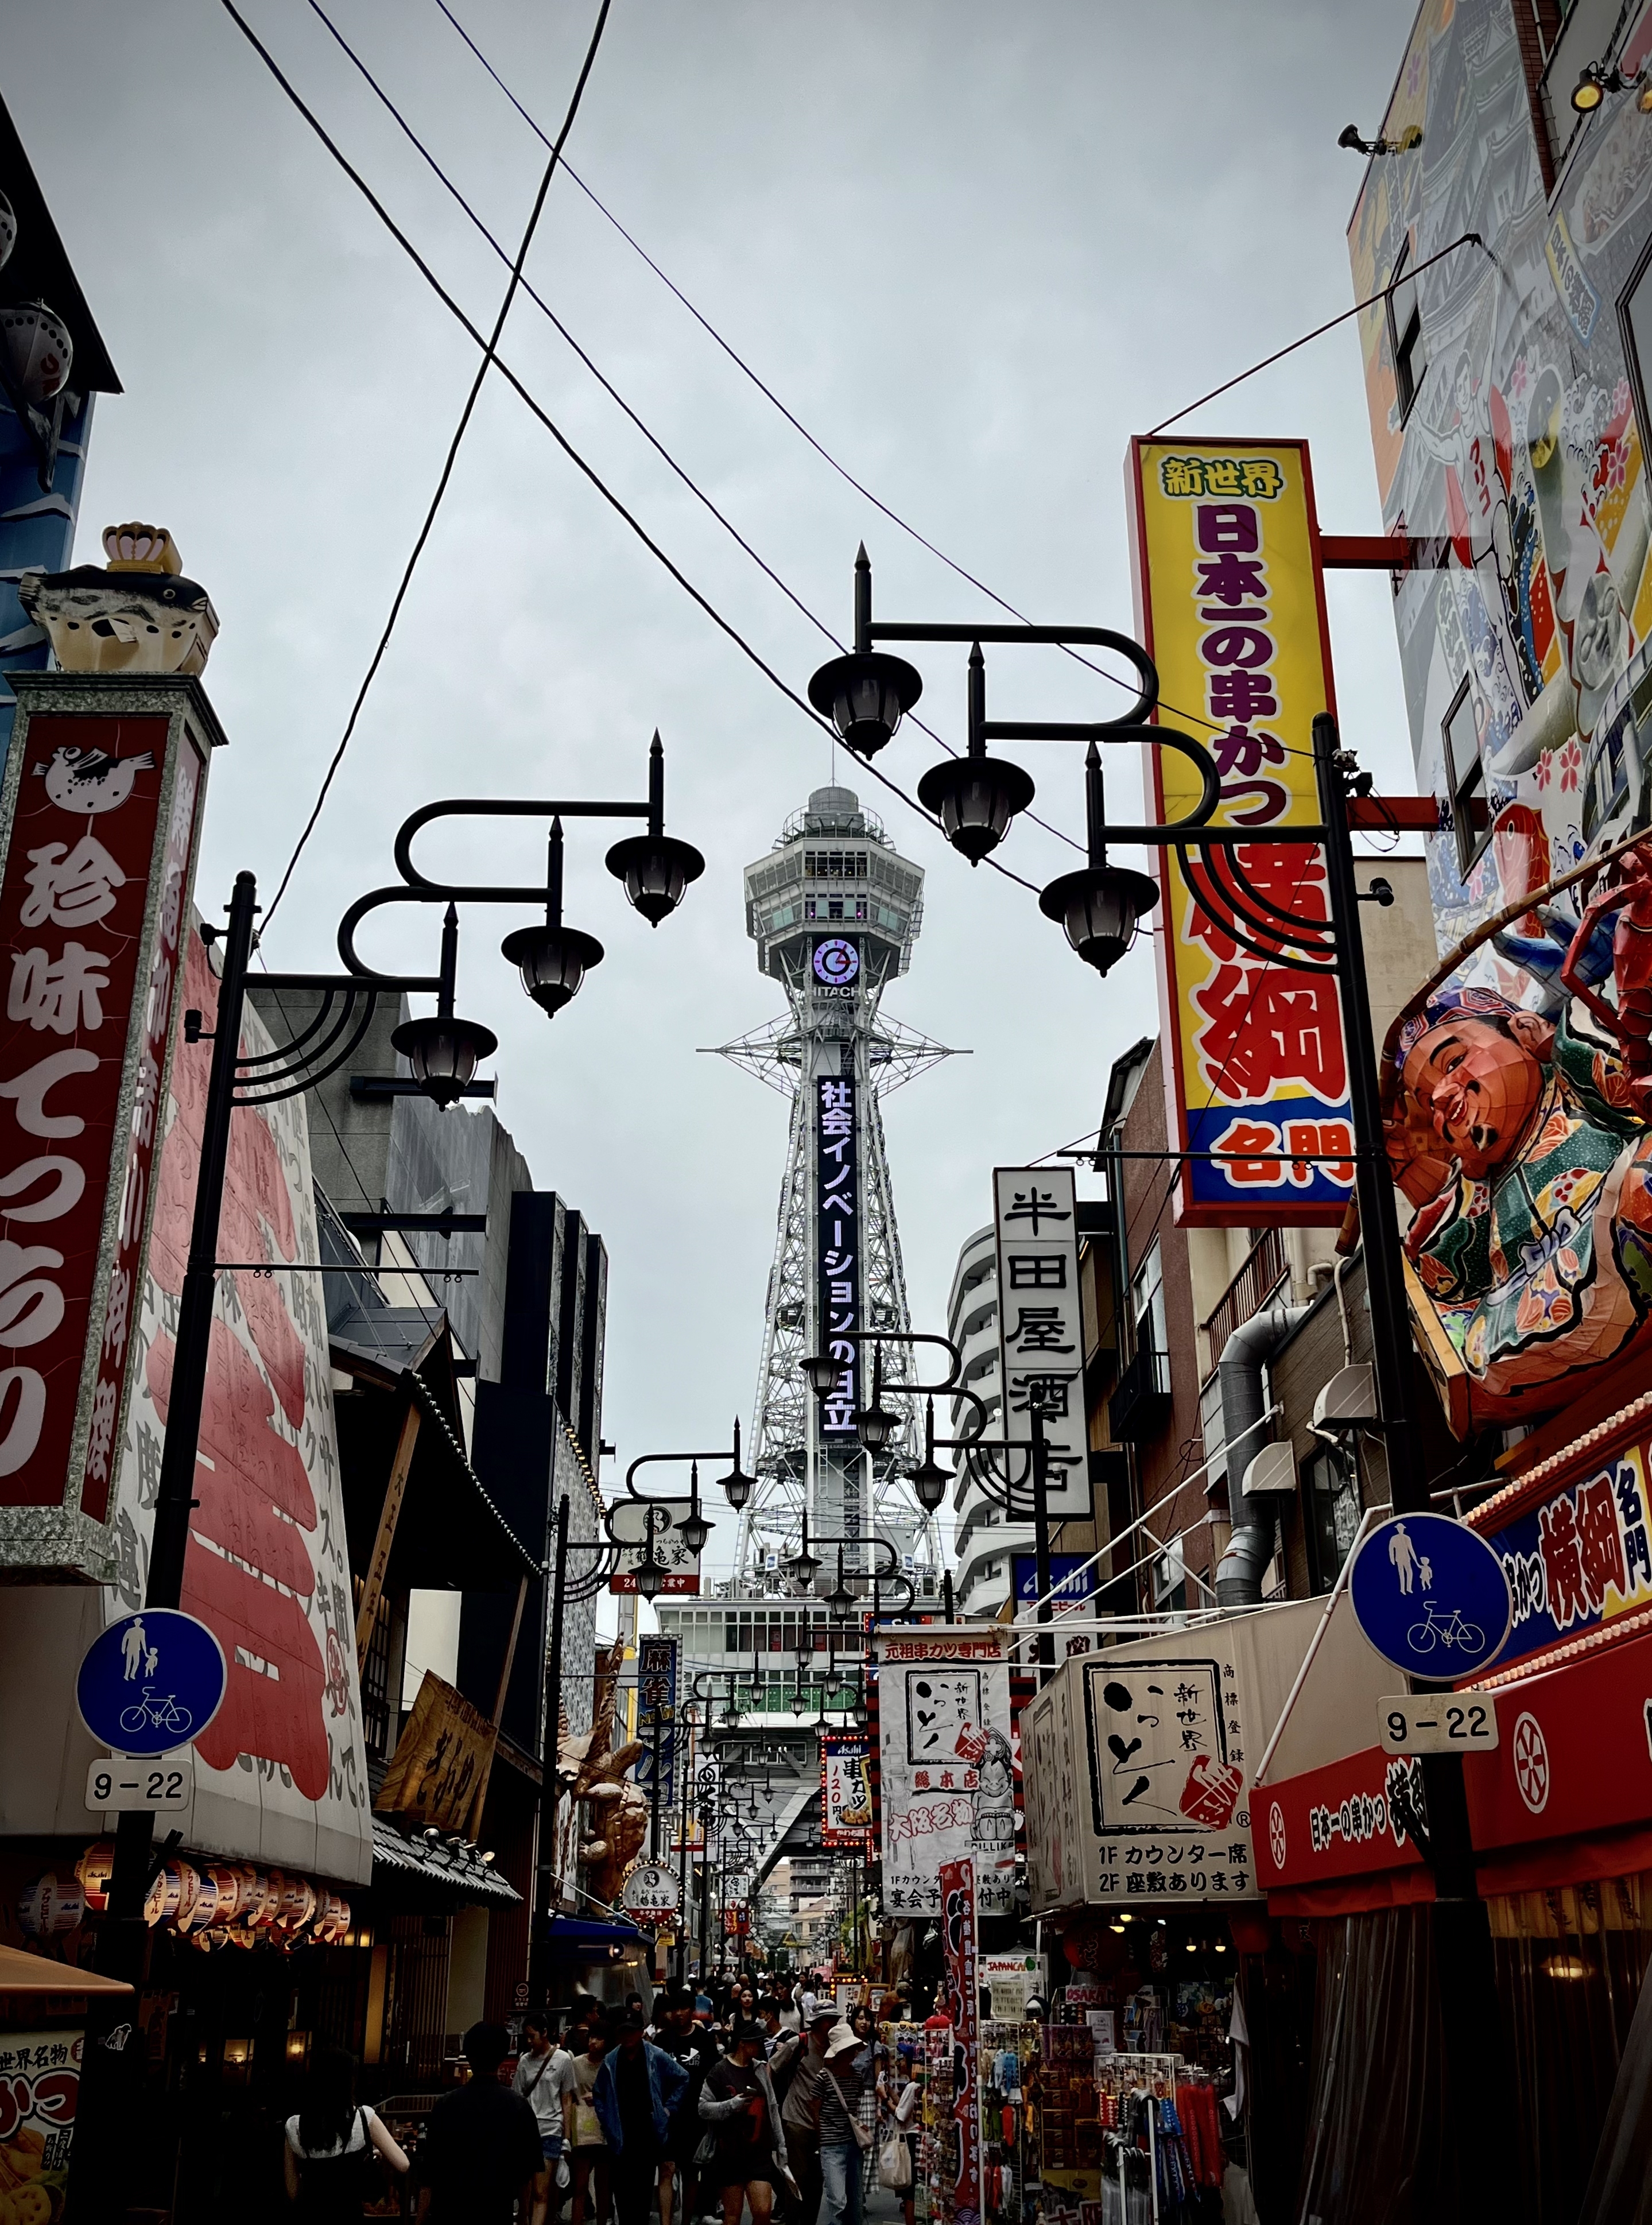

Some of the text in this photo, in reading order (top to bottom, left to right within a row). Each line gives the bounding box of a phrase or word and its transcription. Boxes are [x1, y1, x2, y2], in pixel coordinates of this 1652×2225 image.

[1162, 458, 1283, 498] 新世界
[1470, 437, 1491, 517] グリコ
[1197, 503, 1287, 827] 日本一の串かつ
[1217, 1123, 1354, 1183] 名門
[821, 1081, 857, 1431] 社会イノベーションの日立
[1616, 1466, 1652, 1591] 名門
[623, 1578, 685, 1588] 24業中
[1026, 1601, 1086, 1612] アヒビール
[639, 1642, 673, 1705] 麻雀
[885, 1642, 1002, 1660] 元祖串カツ専門店
[955, 1682, 971, 1720] 新世界
[1173, 1683, 1208, 1752] 新世界
[1223, 1664, 1244, 1762] 商標登録
[837, 1744, 862, 1755] Asahi
[842, 1758, 867, 1810] 串カツ
[889, 1798, 976, 1843] 大阪名物
[1310, 1792, 1386, 1852] 日本一の串かつ
[1099, 1843, 1247, 1865] 1F カウンター席
[890, 1887, 1011, 1908] 宴会予付中
[1099, 1871, 1250, 1893] 2F 座敷あります
